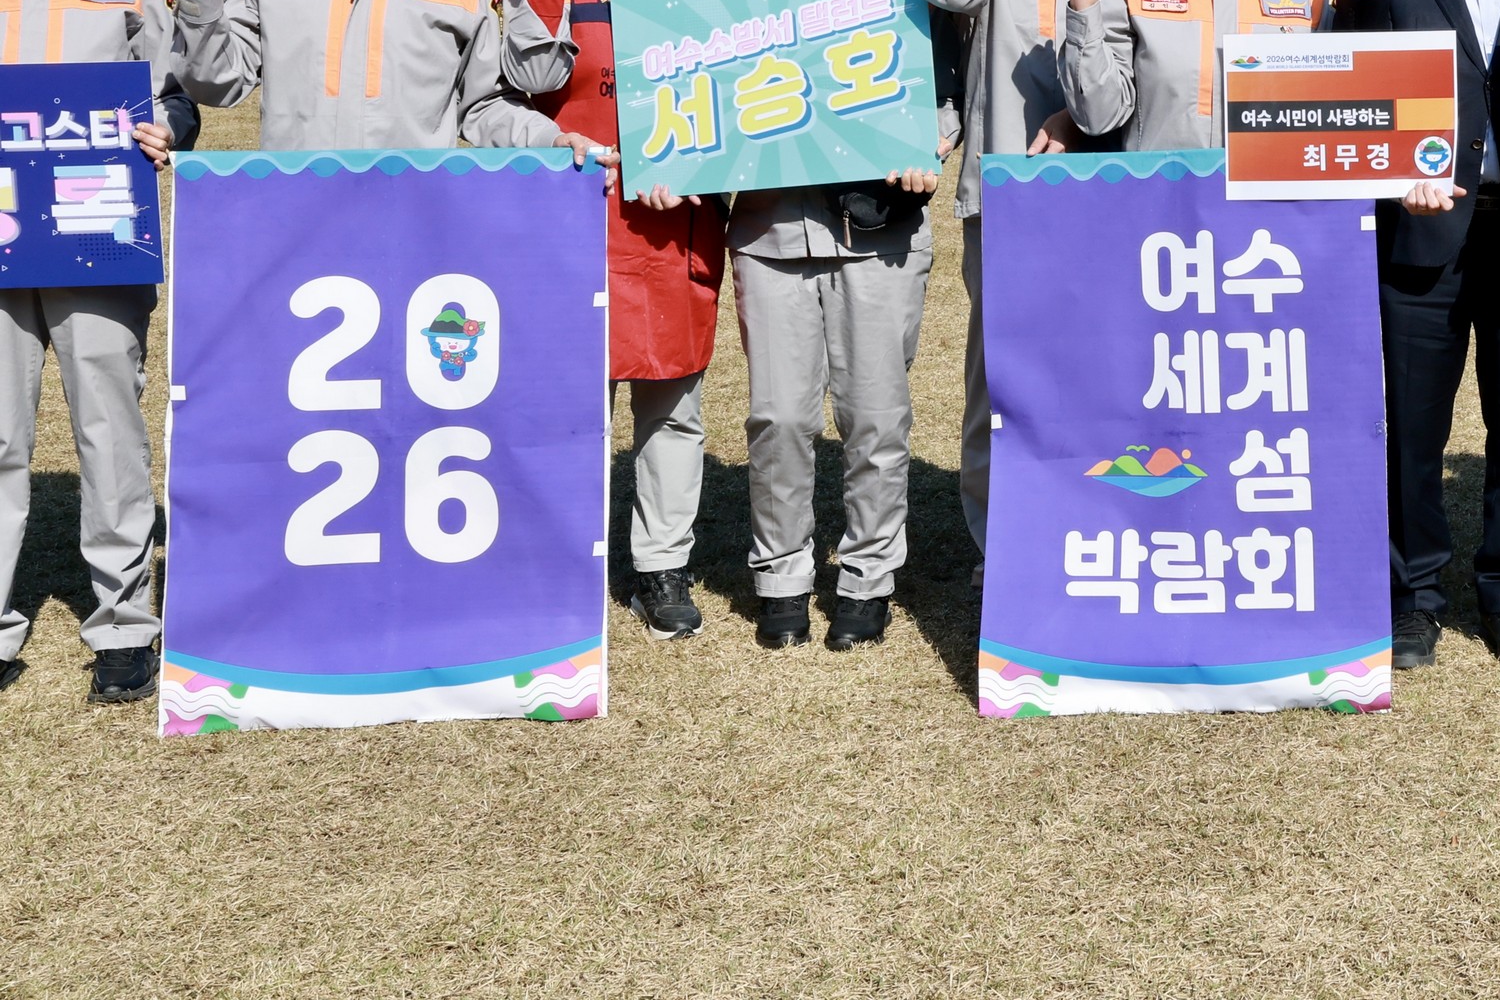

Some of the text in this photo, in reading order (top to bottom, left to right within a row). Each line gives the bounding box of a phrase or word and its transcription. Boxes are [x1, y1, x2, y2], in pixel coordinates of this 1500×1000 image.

[641, 7, 798, 83] 여수소방서
[0, 108, 133, 151] 고스타
[642, 29, 907, 165] 서승호
[1241, 107, 1390, 127] 여수 시민이 사랑하는
[1303, 142, 1390, 171] 최무경
[1140, 228, 1305, 314] 여수
[288, 273, 501, 412] 20
[1142, 327, 1310, 415] 세계
[284, 426, 500, 567] 26
[1228, 427, 1313, 512] 섬
[1063, 526, 1317, 614] 박람회
